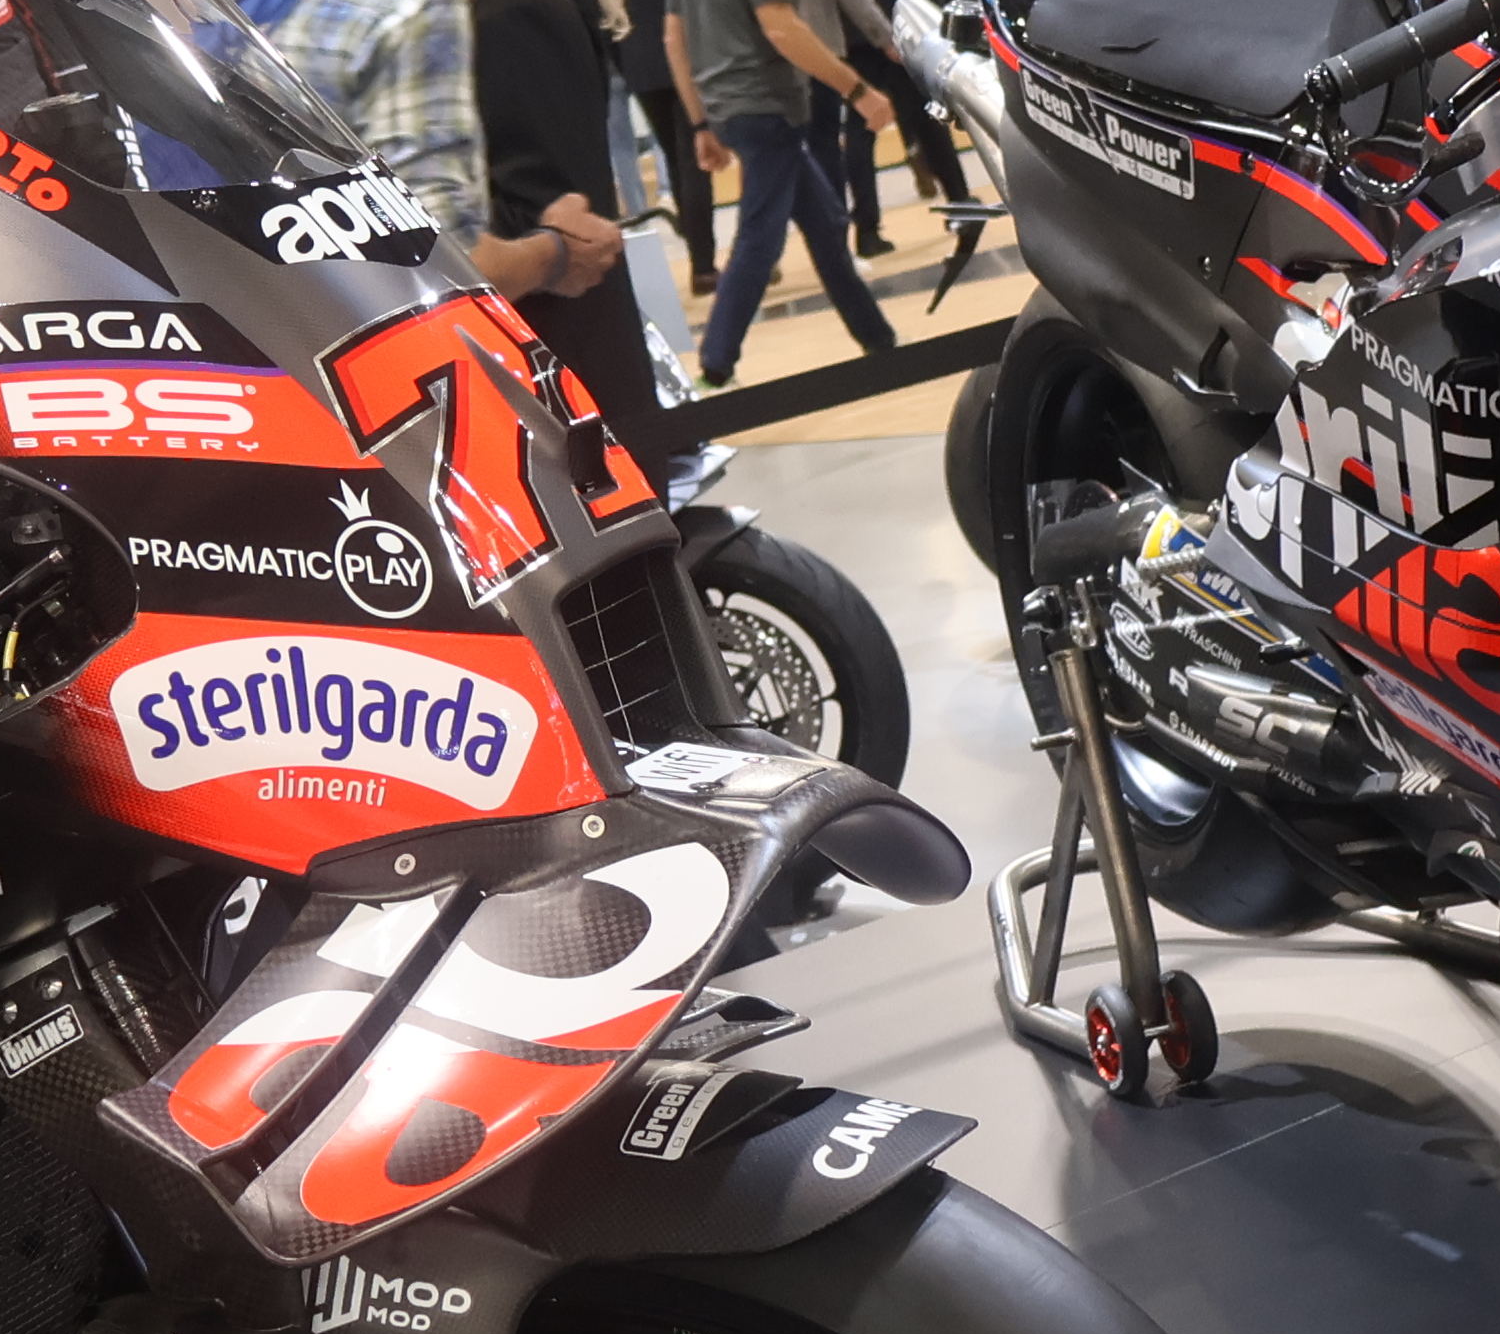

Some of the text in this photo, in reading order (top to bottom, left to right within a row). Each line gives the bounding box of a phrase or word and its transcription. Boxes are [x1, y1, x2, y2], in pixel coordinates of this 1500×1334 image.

[1022, 69, 1074, 124] Green
[1105, 113, 1183, 171] Power
[0, 378, 256, 434] BS
[11, 436, 260, 453] BATTERY
[128, 536, 334, 581] PRAGMATIC
[345, 552, 429, 591] PLAY
[137, 646, 510, 778] sterilgarda
[1218, 696, 1303, 755] SC
[257, 768, 388, 807] alimenti
[637, 749, 733, 781] wifi
[0, 1013, 77, 1071] ÖHLINS
[629, 1082, 696, 1150] Green
[811, 1097, 924, 1180] CAME
[366, 1304, 432, 1332] MOD
[370, 1273, 473, 1316] MOD
